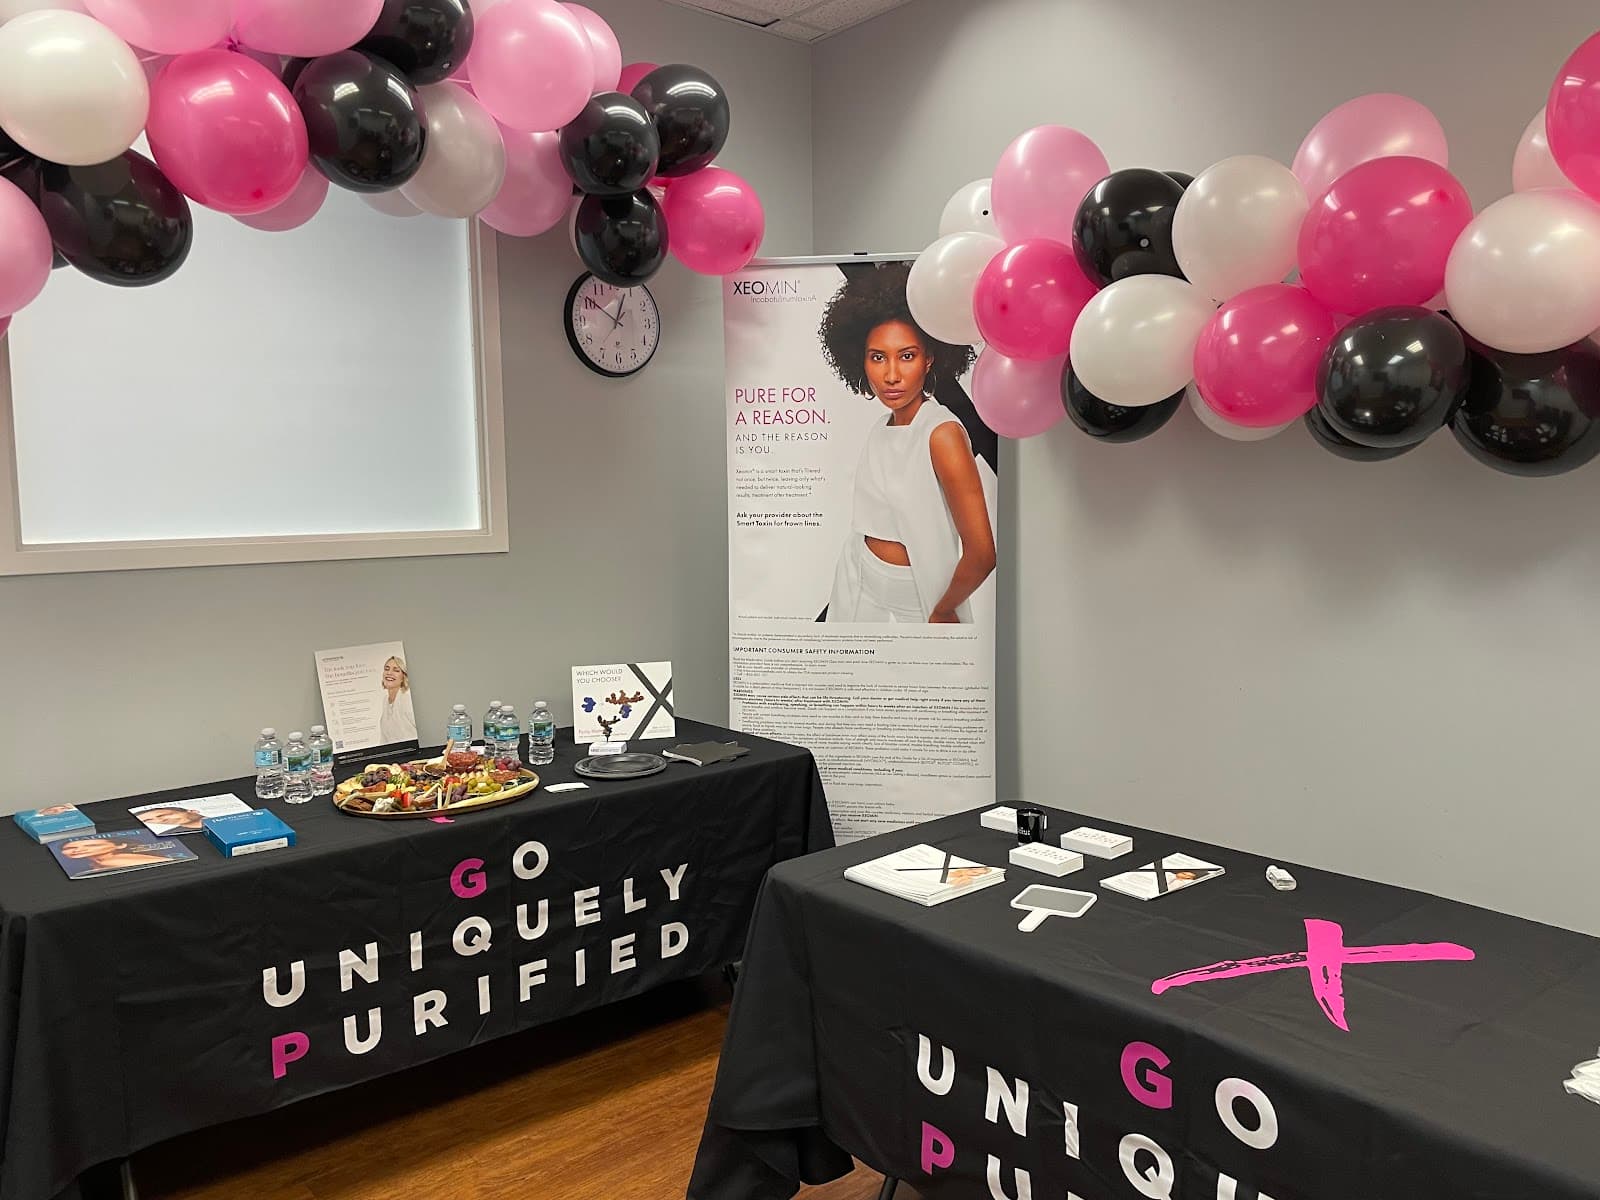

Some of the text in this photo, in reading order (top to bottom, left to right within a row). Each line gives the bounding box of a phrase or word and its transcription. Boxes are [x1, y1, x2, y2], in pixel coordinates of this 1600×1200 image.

[735, 387, 816, 404] PURE FOR
[735, 409, 831, 425] A REASON.
[735, 432, 828, 442] AND THE REASON
[735, 446, 745, 455] IS
[450, 840, 549, 899] GO
[262, 863, 689, 1008] UNIQUELY
[271, 921, 689, 1080] PURIFIED
[1120, 1041, 1279, 1150] GO
